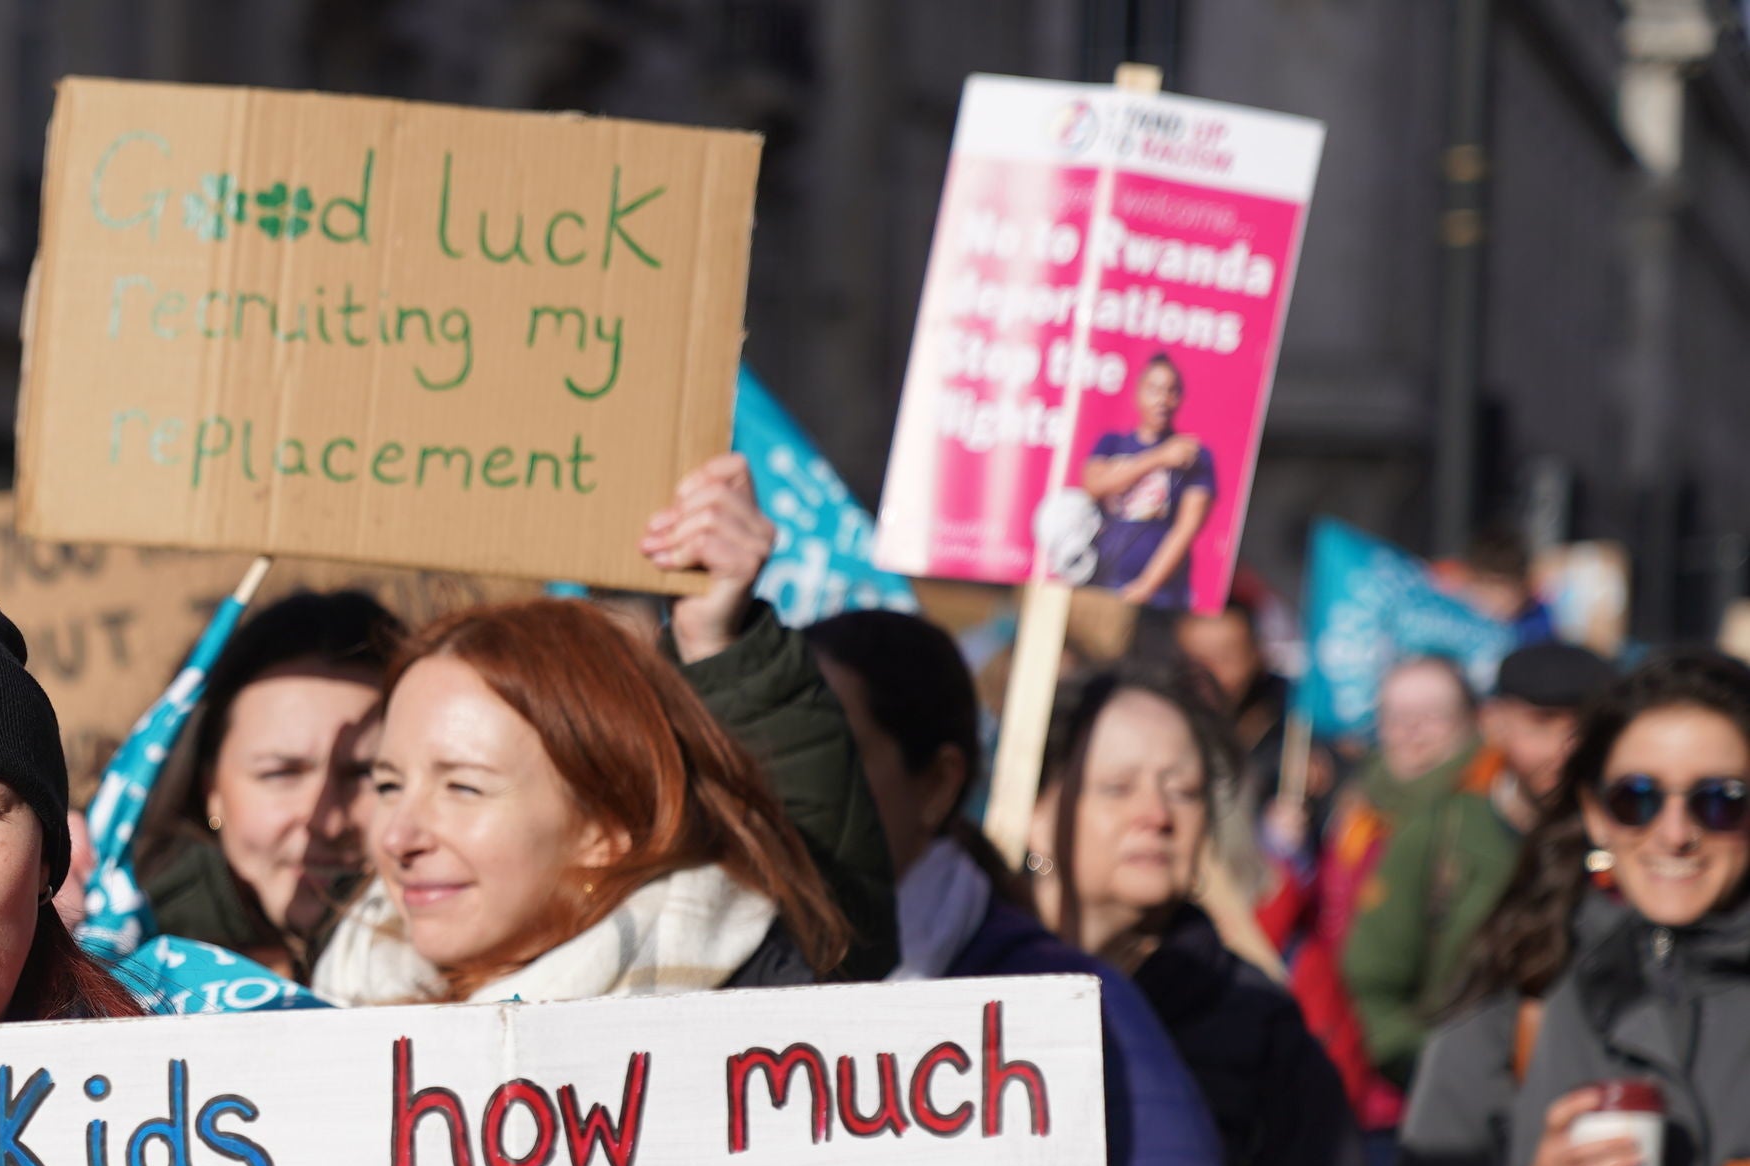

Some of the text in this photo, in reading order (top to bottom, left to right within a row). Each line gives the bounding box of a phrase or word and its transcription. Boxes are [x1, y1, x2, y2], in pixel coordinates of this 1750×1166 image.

[438, 150, 667, 271] luck
[109, 273, 625, 401] recruiting my
[109, 408, 598, 495] replacement
[727, 1000, 1050, 1153] much
